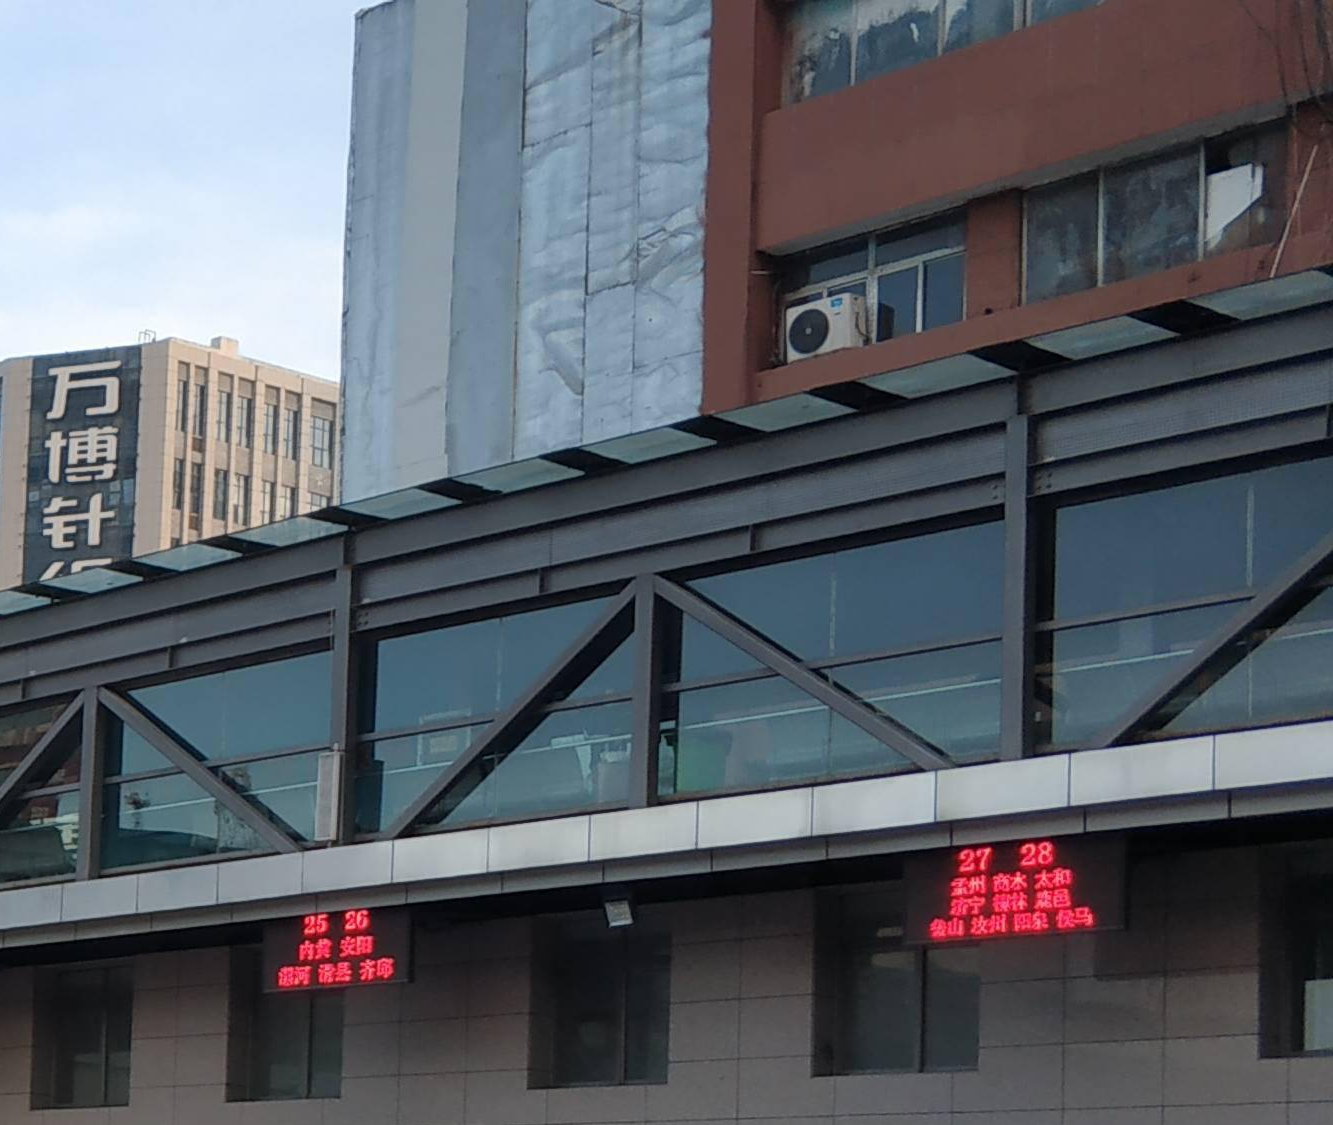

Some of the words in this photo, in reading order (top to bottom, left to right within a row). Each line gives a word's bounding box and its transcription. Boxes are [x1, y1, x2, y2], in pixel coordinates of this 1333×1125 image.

[957, 847, 992, 873] 27
[1020, 840, 1055, 867] 28
[1034, 867, 1072, 889] 太和
[303, 913, 329, 936] 25
[344, 909, 369, 931] 26
